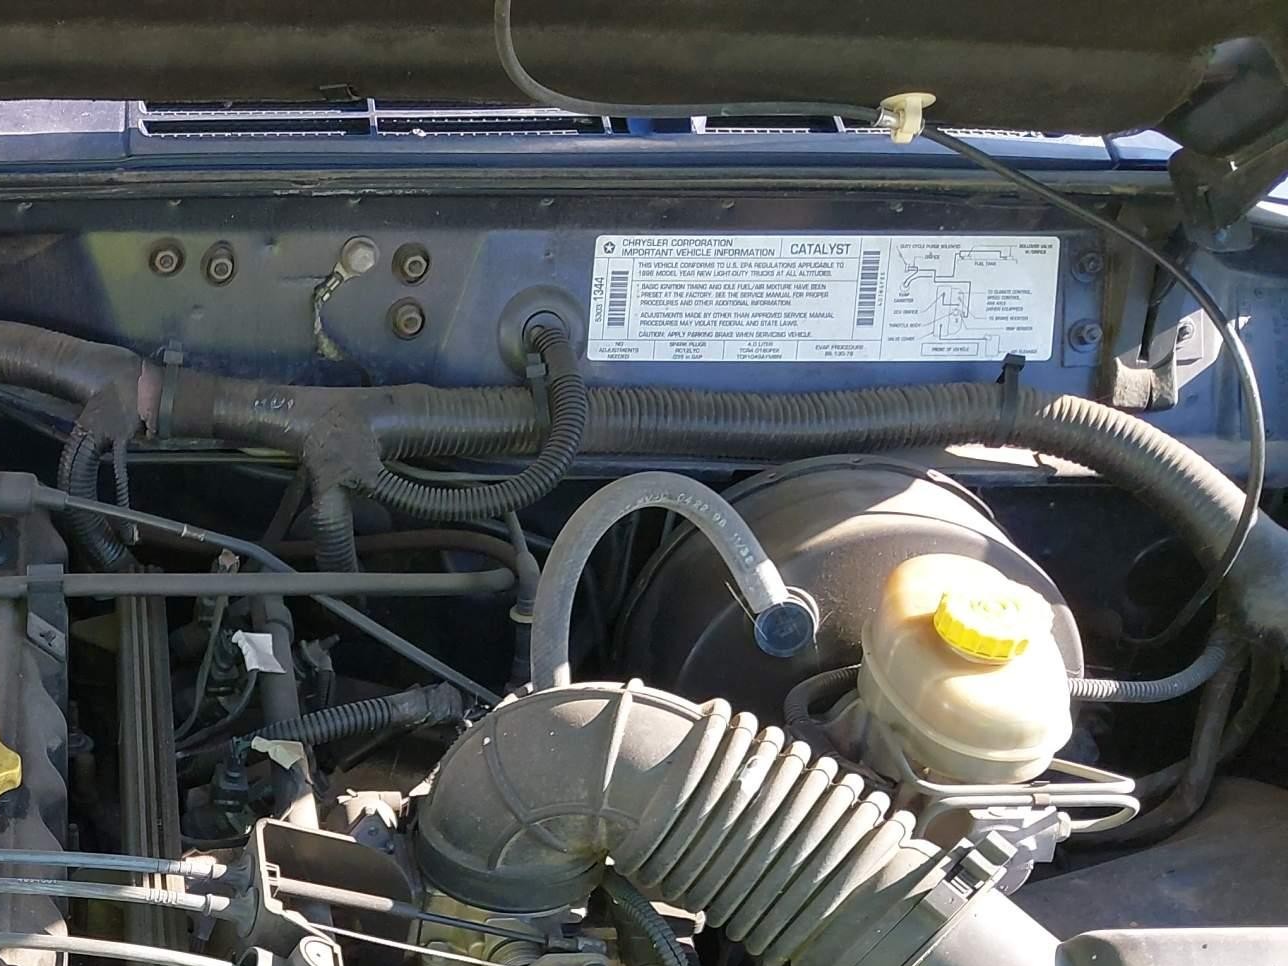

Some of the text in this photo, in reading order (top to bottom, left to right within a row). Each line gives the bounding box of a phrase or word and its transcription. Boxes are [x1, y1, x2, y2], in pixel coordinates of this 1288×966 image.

[621, 238, 733, 247] CHRYSLER CORPORATION
[621, 248, 775, 257] IMPORTANT VEHICLE INFORMATION
[791, 243, 851, 255] CATALYST
